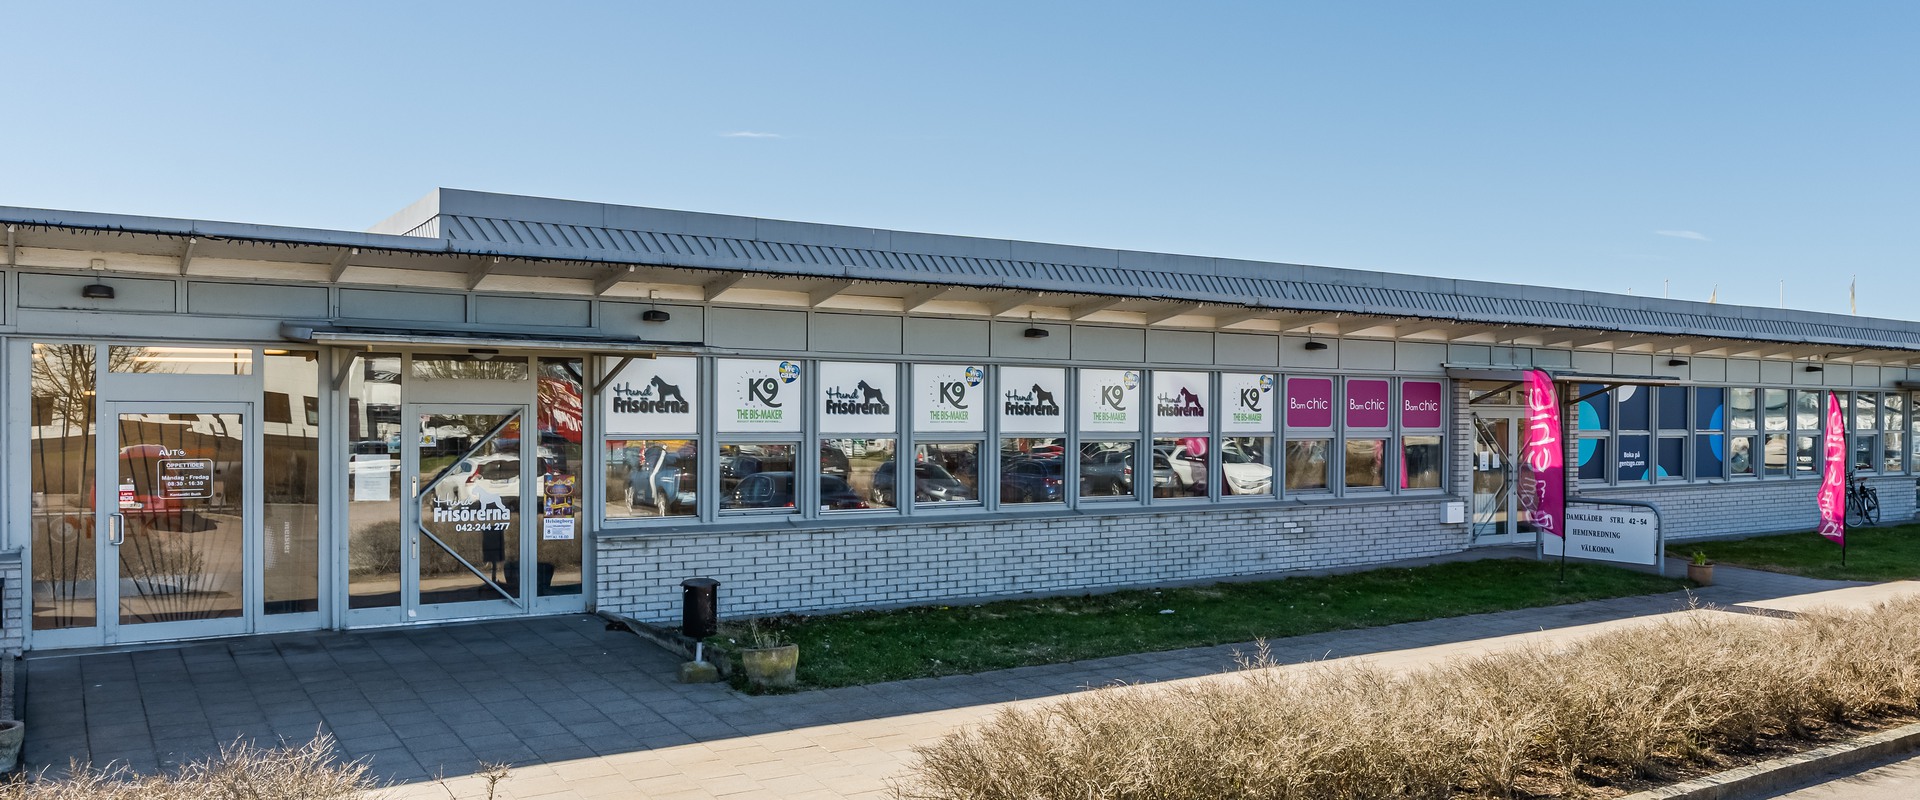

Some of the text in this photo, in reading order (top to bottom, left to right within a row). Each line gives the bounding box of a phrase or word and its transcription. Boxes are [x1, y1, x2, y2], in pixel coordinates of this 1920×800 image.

[613, 382, 653, 396] Hund
[749, 378, 782, 408] K9
[826, 386, 859, 399] Hund
[1005, 389, 1033, 401] Hund
[940, 382, 968, 410] K9
[1102, 385, 1126, 411] K9
[1157, 392, 1181, 403] Hund
[1241, 388, 1261, 412] K9
[613, 396, 689, 413] Frisörerna
[826, 400, 890, 415] Frisörerna
[1005, 402, 1059, 416] Frisörerna
[1290, 398, 1328, 410] Bam chic
[1349, 399, 1385, 411] Bam chic
[1405, 400, 1438, 411] Bam chic
[737, 409, 782, 420] THE BIS-MAKER
[930, 411, 968, 420] THE BIS-MAKER
[1093, 412, 1126, 421] THE BIS-MAKER
[1157, 404, 1204, 417] Frisörerna
[433, 493, 472, 507] Hund
[433, 507, 511, 522] Frisörerna
[1566, 513, 1603, 522] DAMKLÄDER
[455, 522, 511, 532] 042-244 277
[1572, 528, 1621, 539] HEMINREDNING
[1580, 544, 1615, 554] VÄLKOMNA
